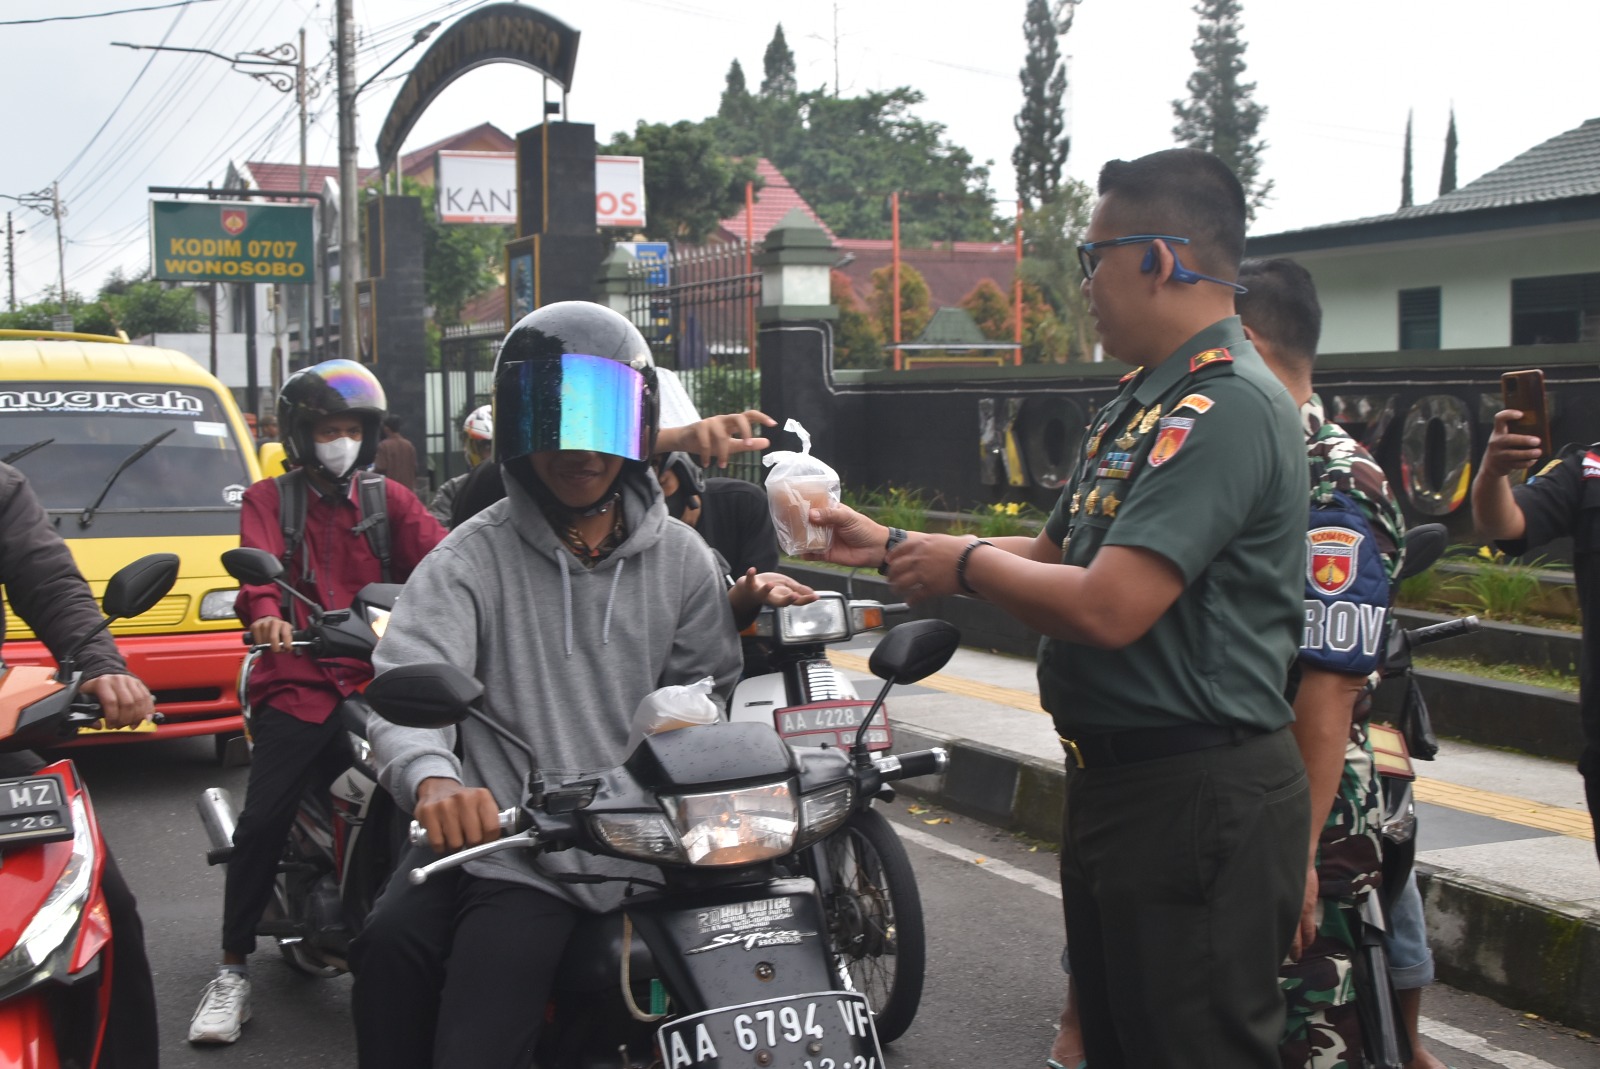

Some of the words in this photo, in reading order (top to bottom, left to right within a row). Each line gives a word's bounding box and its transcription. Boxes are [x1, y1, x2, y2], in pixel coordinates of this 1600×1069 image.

[447, 187, 517, 213] KAN
[170, 238, 242, 257] KODIM
[247, 241, 298, 259] 0707
[165, 259, 305, 277] WONOSOBO
[784, 712, 807, 732] AA
[815, 708, 855, 727] 4228
[9, 784, 54, 809] MZ
[670, 1023, 719, 1069] AA
[733, 1002, 824, 1051] 6794
[837, 999, 869, 1038] VF
